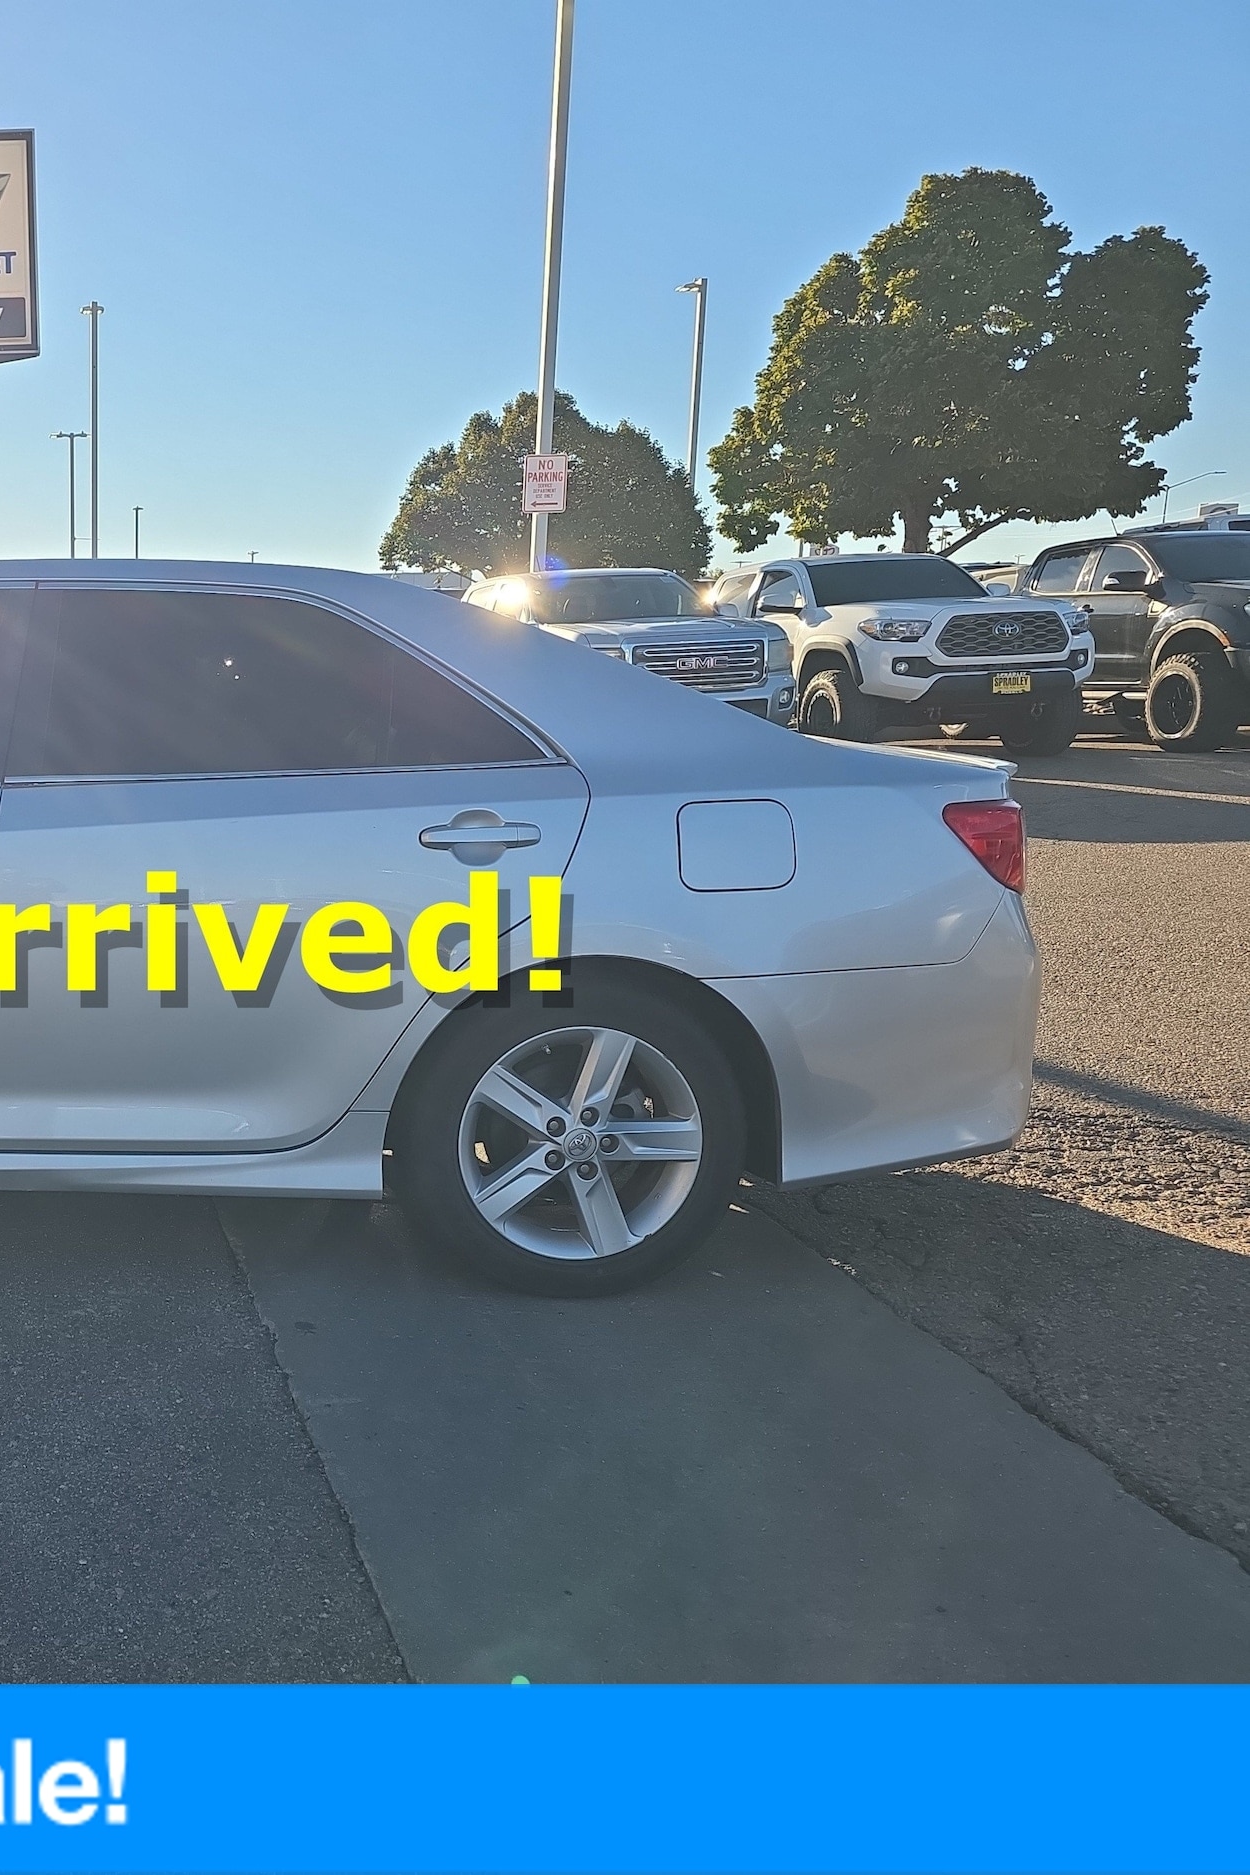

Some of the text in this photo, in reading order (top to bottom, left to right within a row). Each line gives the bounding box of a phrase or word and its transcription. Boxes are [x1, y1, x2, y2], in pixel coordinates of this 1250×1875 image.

[538, 460, 554, 470] NO
[528, 472, 564, 482] PARKING
[676, 656, 729, 670] GMC
[994, 676, 1029, 687] SPRADLEY
